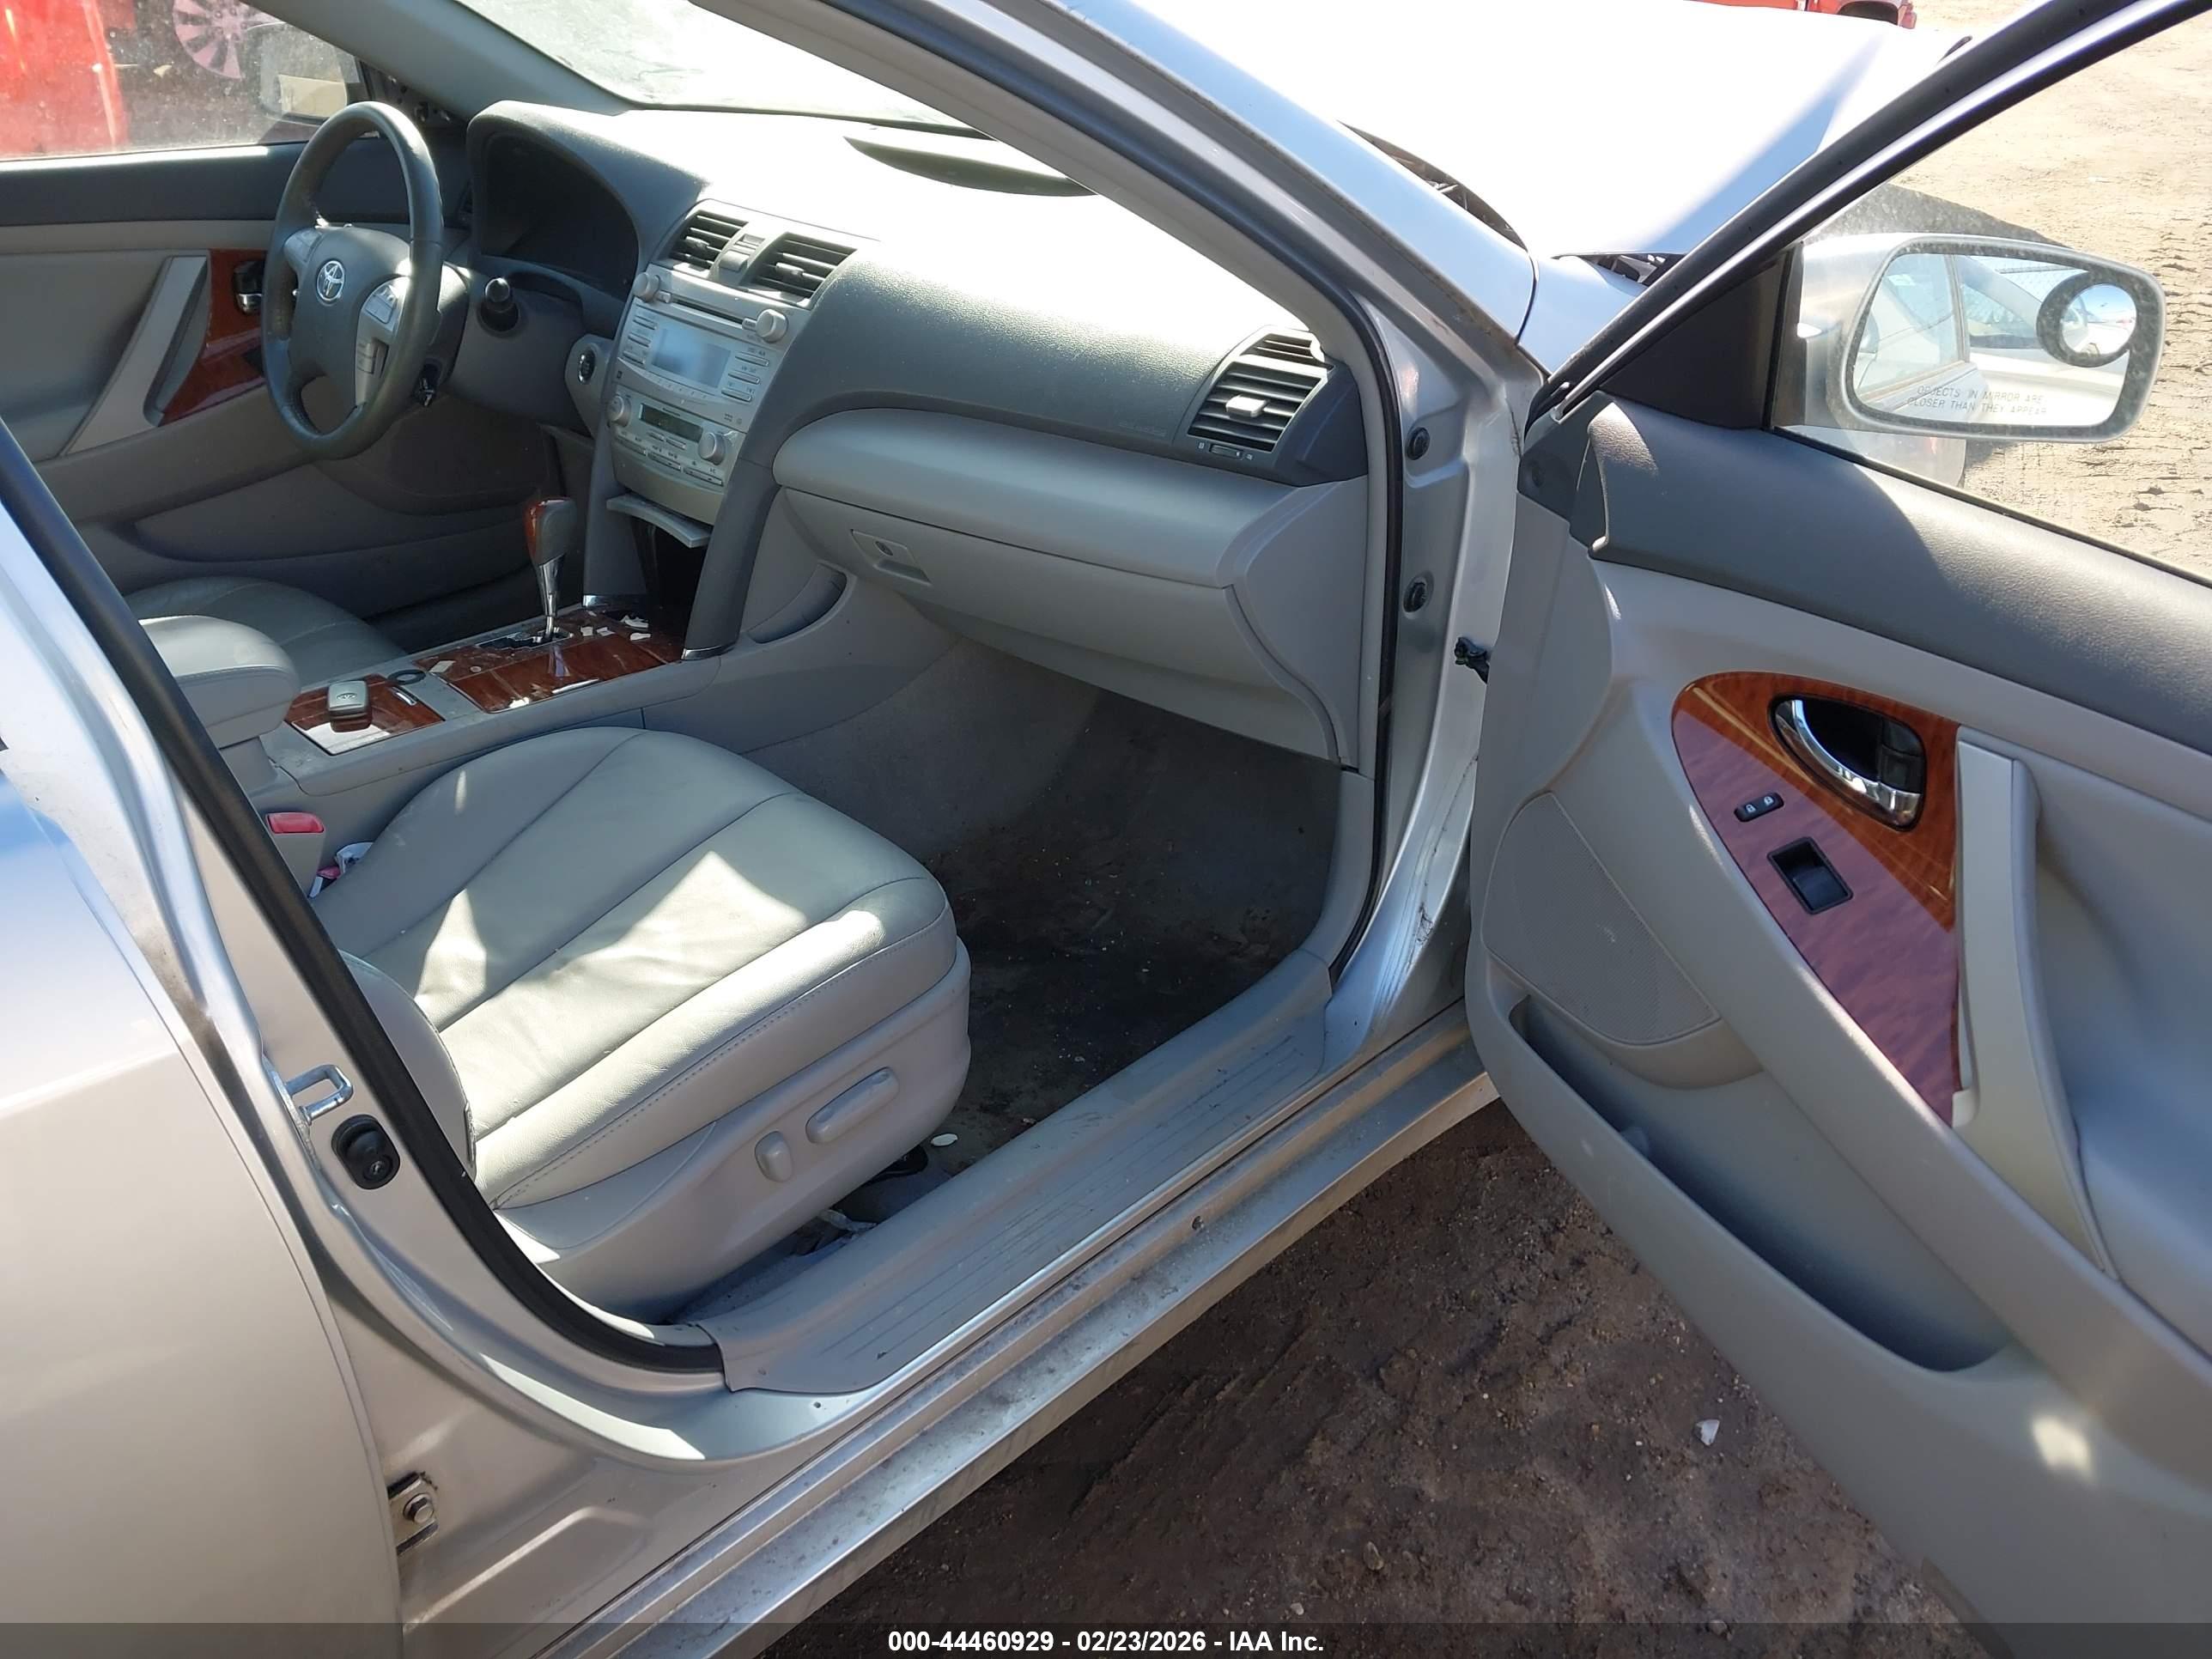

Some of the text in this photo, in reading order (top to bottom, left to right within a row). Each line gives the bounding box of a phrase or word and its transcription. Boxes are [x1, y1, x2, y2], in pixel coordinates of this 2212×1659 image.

[1917, 386, 1960, 398] OBJECTS
[1967, 389, 1978, 399] IN
[1982, 391, 2021, 401] MIRROR
[1950, 399, 1976, 412] THAN
[1981, 401, 2004, 413] THEY
